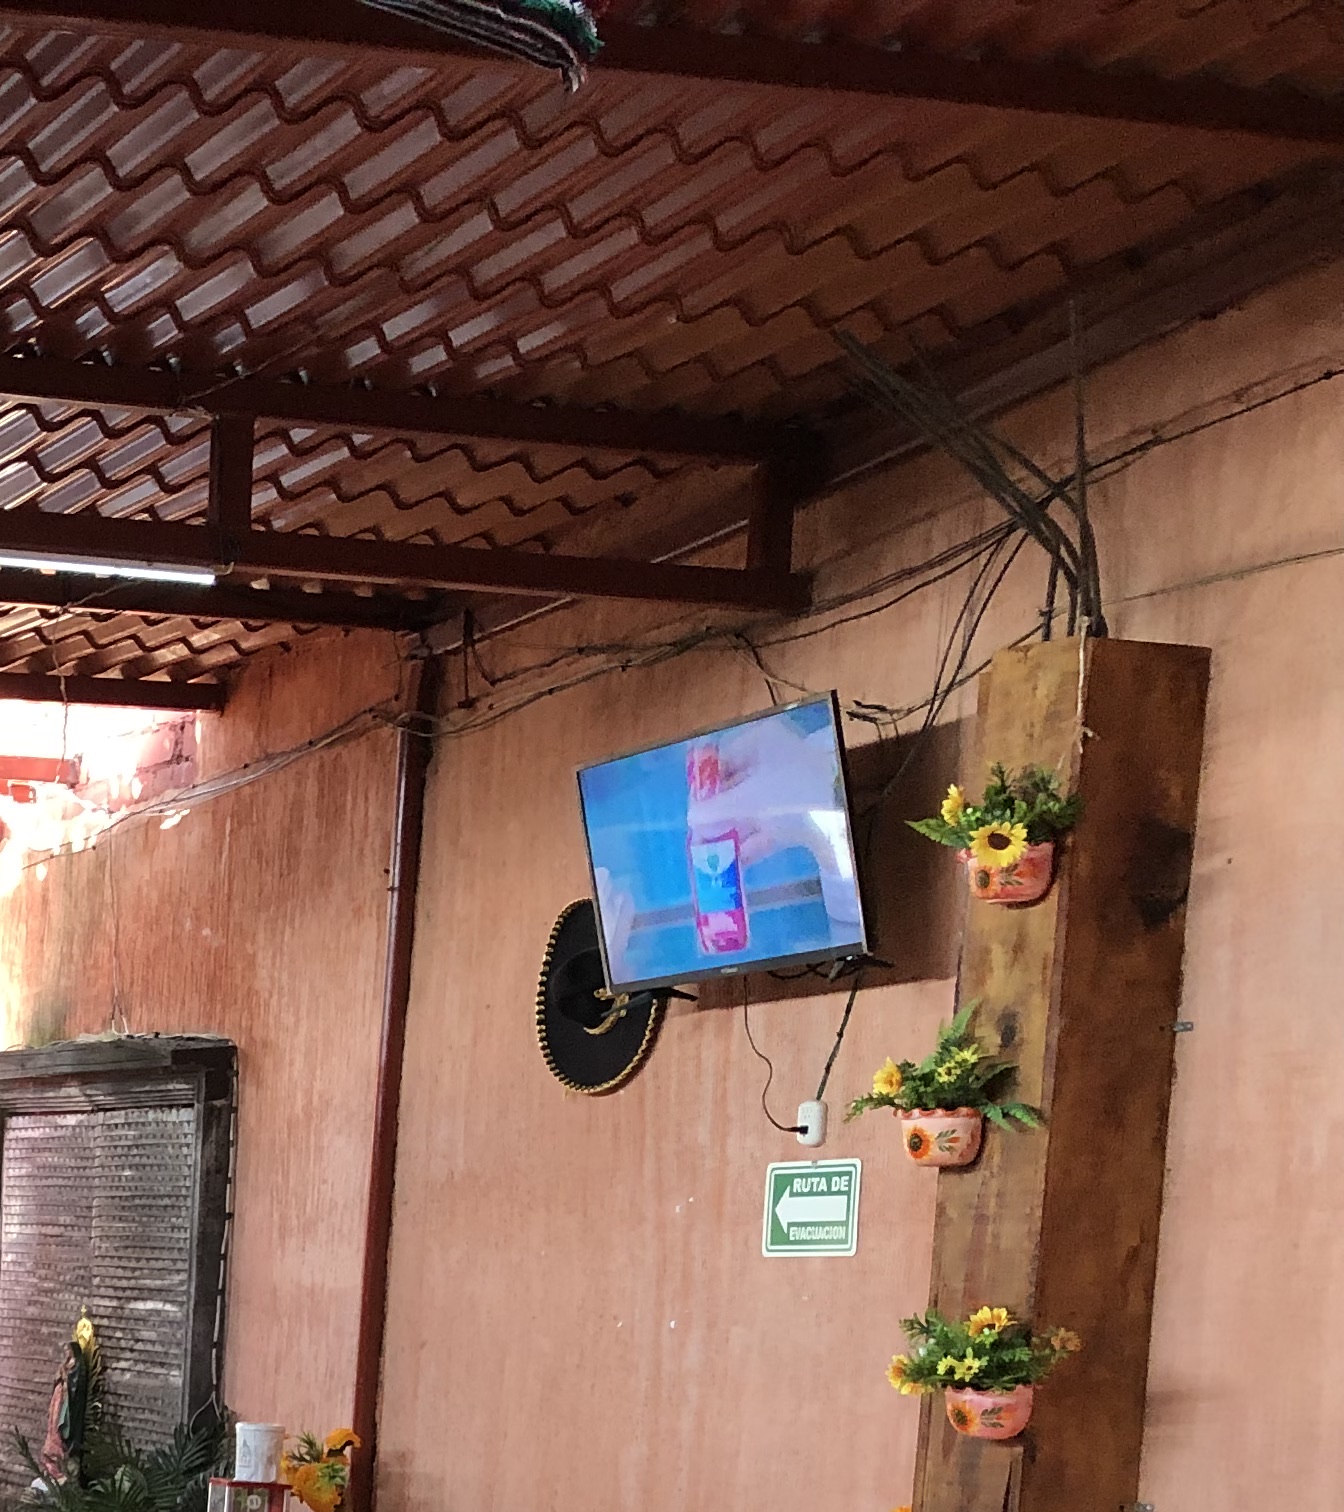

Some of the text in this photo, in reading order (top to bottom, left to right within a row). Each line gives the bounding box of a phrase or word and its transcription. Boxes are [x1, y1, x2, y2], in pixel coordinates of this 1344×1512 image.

[792, 1176, 850, 1193] RUTA DE
[789, 1226, 847, 1241] EVACUACION
